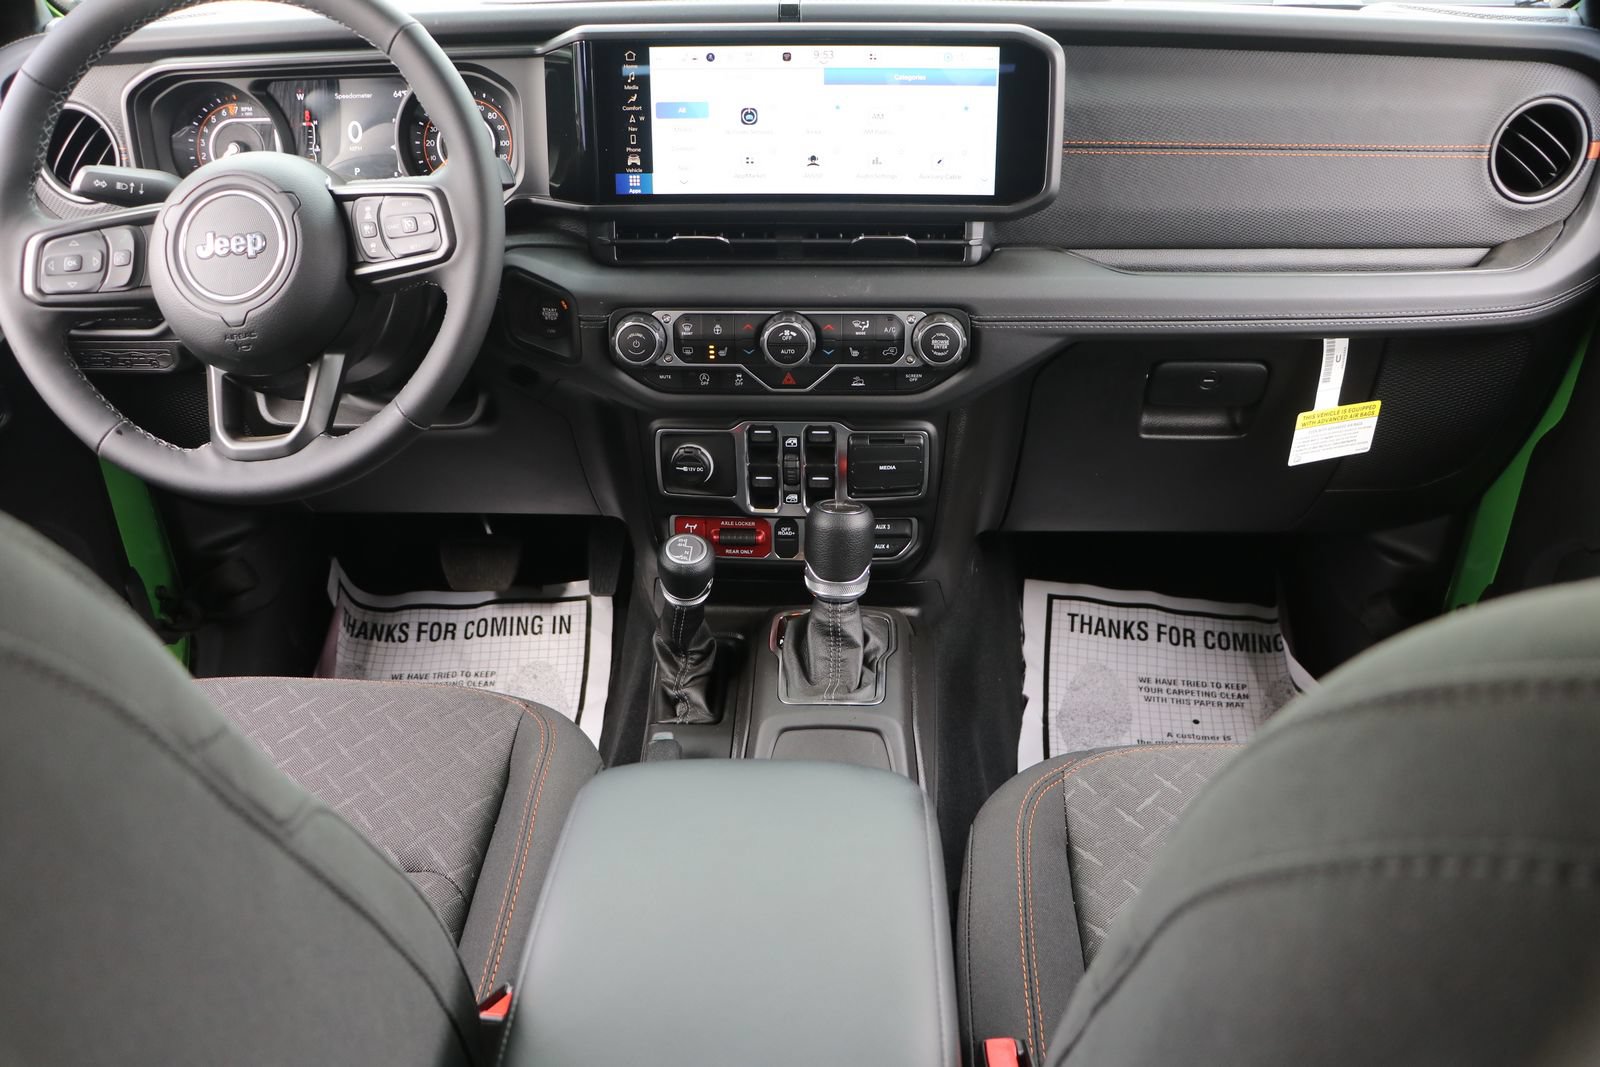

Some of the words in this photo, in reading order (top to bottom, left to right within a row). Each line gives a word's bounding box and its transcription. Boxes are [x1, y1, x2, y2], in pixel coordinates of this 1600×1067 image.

[354, 167, 360, 175] P
[196, 231, 266, 259] Jeep
[1348, 405, 1376, 413] EQUIPPED
[1317, 415, 1348, 424] ADVANCED
[342, 608, 410, 643] THANKS
[416, 621, 456, 642] FOR
[464, 615, 543, 640] COMING
[552, 614, 572, 635] IN
[1067, 613, 1149, 641] THANKS
[1156, 623, 1196, 648] FOR
[1204, 630, 1284, 653] COMING
[1181, 680, 1207, 688] TRIED
[1138, 686, 1163, 694] YOUR
[1166, 688, 1217, 698] CARPETING
[1220, 692, 1249, 700] CLEAN
[1171, 698, 1191, 706] THIS
[1194, 700, 1223, 708] PAPER
